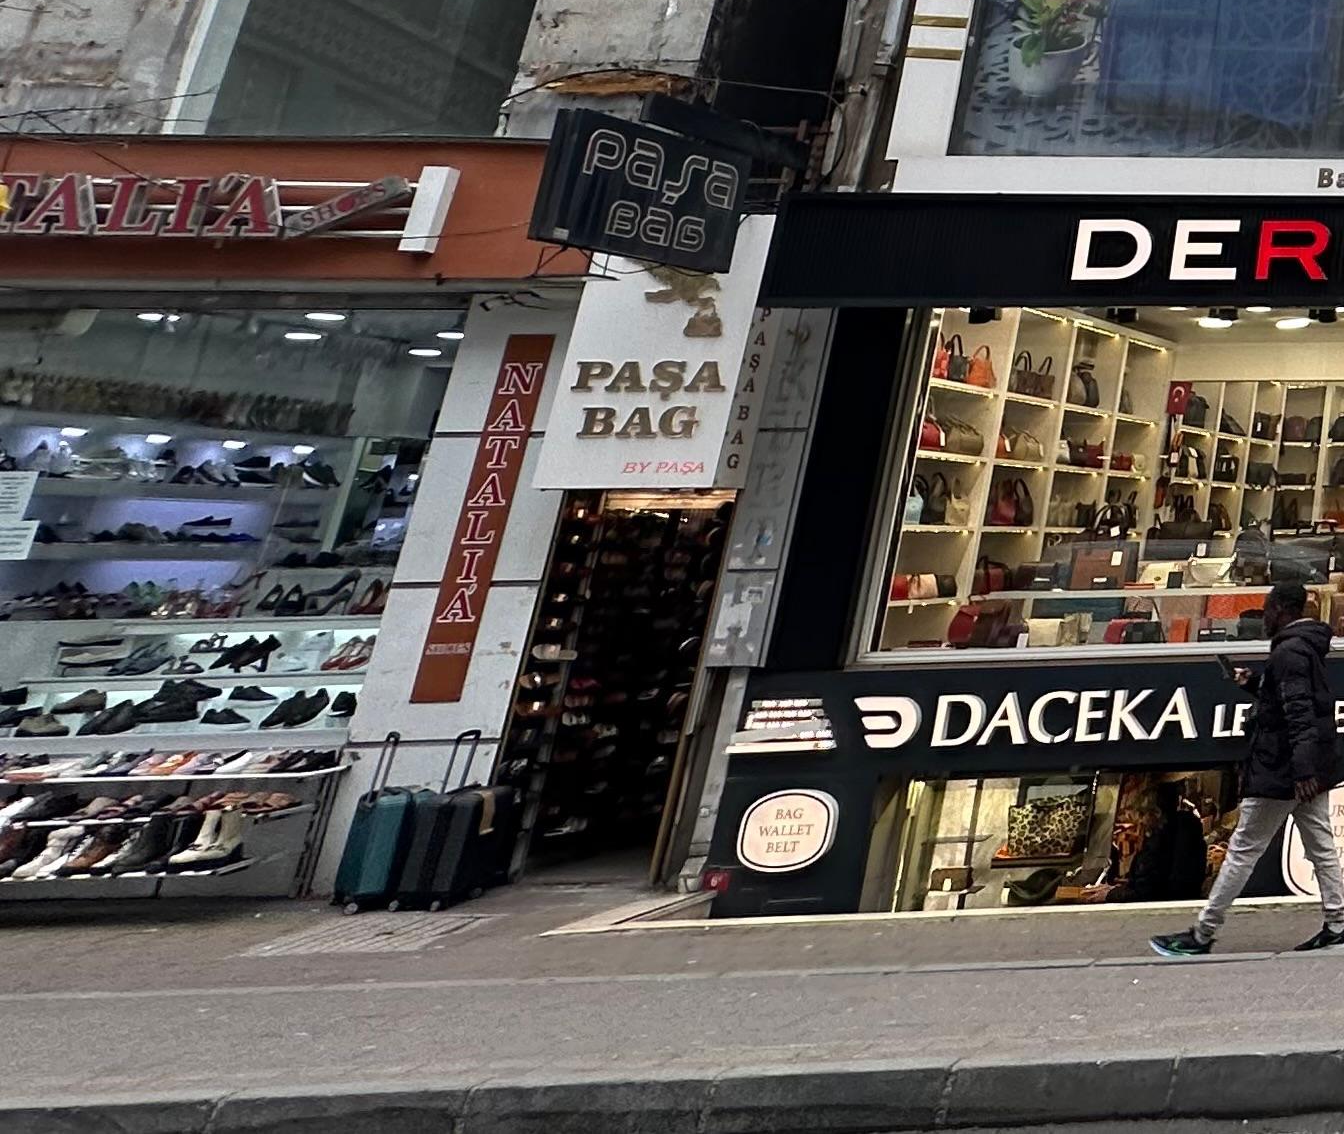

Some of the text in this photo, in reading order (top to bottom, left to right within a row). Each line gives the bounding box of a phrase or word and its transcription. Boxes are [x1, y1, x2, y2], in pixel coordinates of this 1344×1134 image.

[571, 361, 725, 400] PAŞA
[576, 406, 699, 439] BAG
[621, 462, 705, 475] BY PAŞA
[930, 686, 1198, 748] DACEKA
[775, 808, 804, 820] BAG
[758, 824, 814, 837] WALLET
[765, 840, 800, 854] BELT
